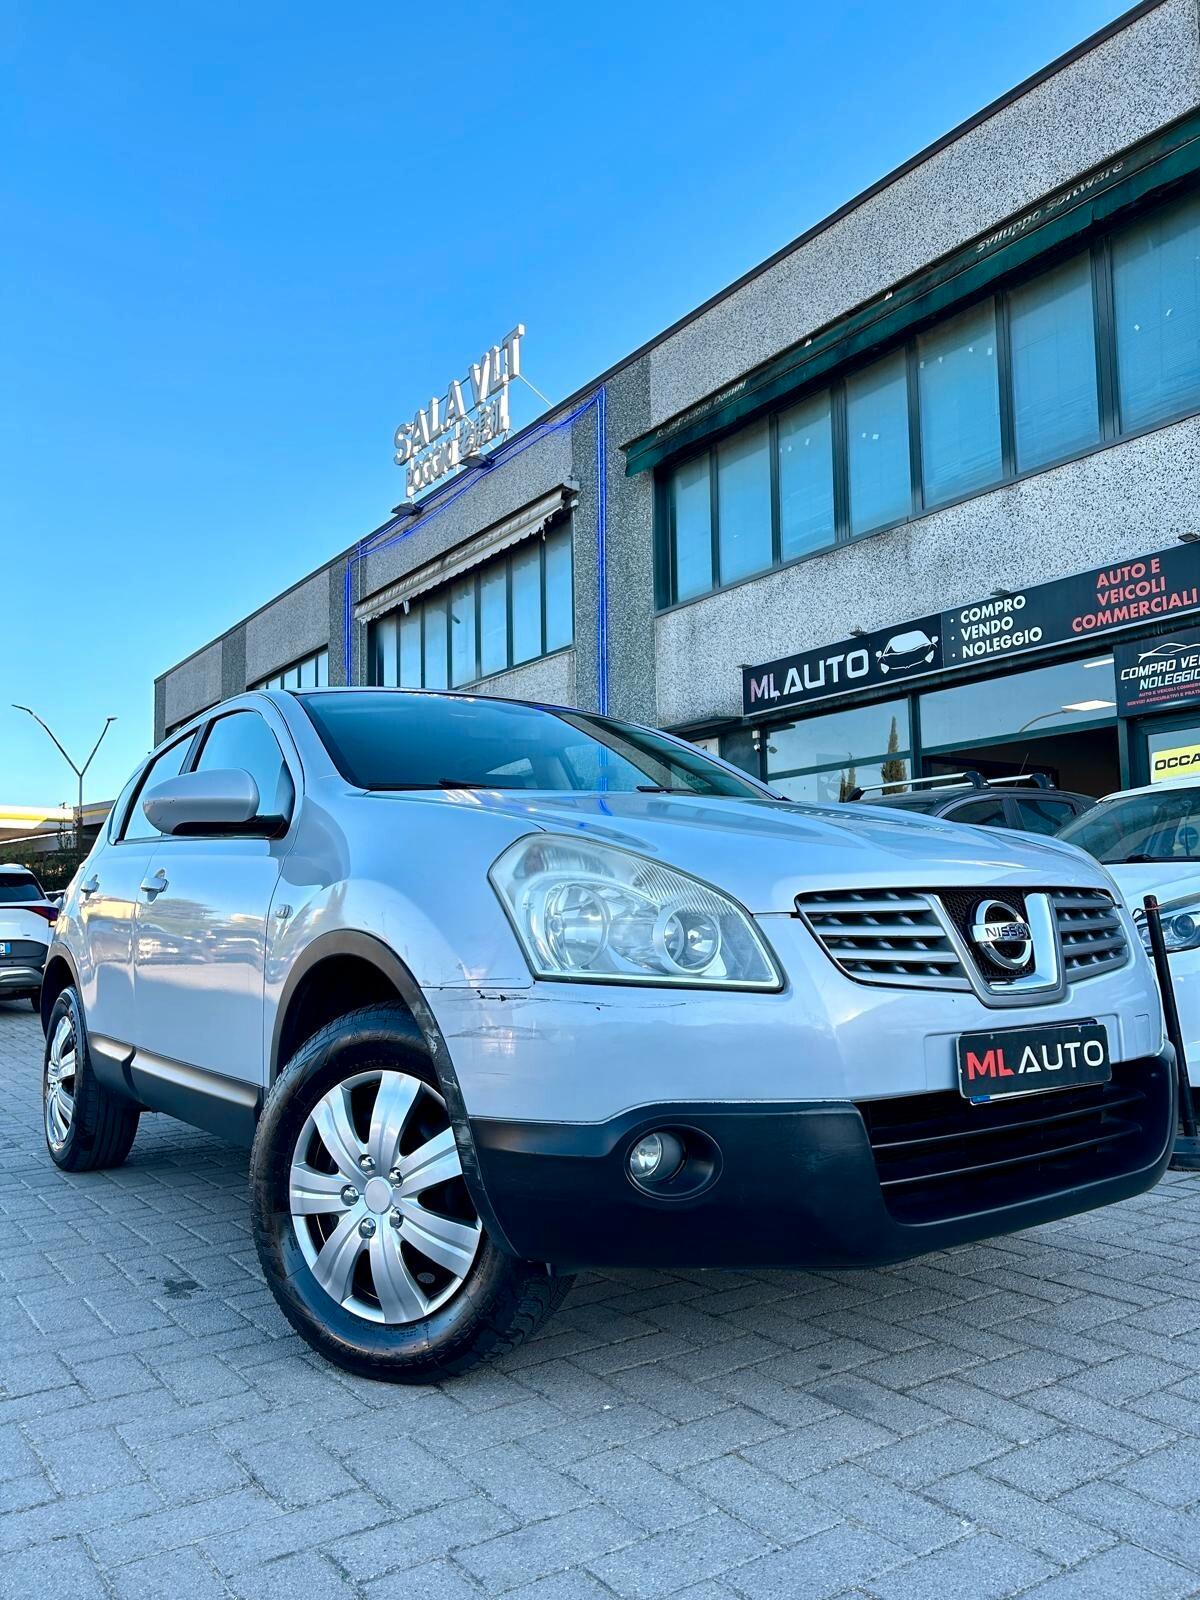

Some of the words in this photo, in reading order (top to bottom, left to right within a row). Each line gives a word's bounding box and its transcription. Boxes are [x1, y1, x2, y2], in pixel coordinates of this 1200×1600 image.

[975, 209, 1041, 254] Sviluppo
[393, 379, 466, 466] SALA
[468, 323, 525, 407] VLT
[1096, 562, 1147, 589] AUTO
[1150, 558, 1161, 575] E
[1096, 576, 1166, 607] VEICOLI
[960, 595, 1026, 624] COMPRO
[1072, 588, 1198, 632] COMMERCIALI
[961, 616, 1014, 642] VENDO
[962, 627, 1043, 659] NOLEGGIO
[750, 673, 780, 703] ML
[783, 648, 870, 696] AUTO
[1120, 658, 1176, 681] COMPRO
[1180, 654, 1200, 669] VE
[1138, 690, 1152, 698] AUTO
[1157, 686, 1176, 695] VEICOLI
[1146, 692, 1179, 704] ASSICURATIVI
[966, 1048, 1015, 1080] ML
[1018, 1040, 1104, 1074] AUTO
